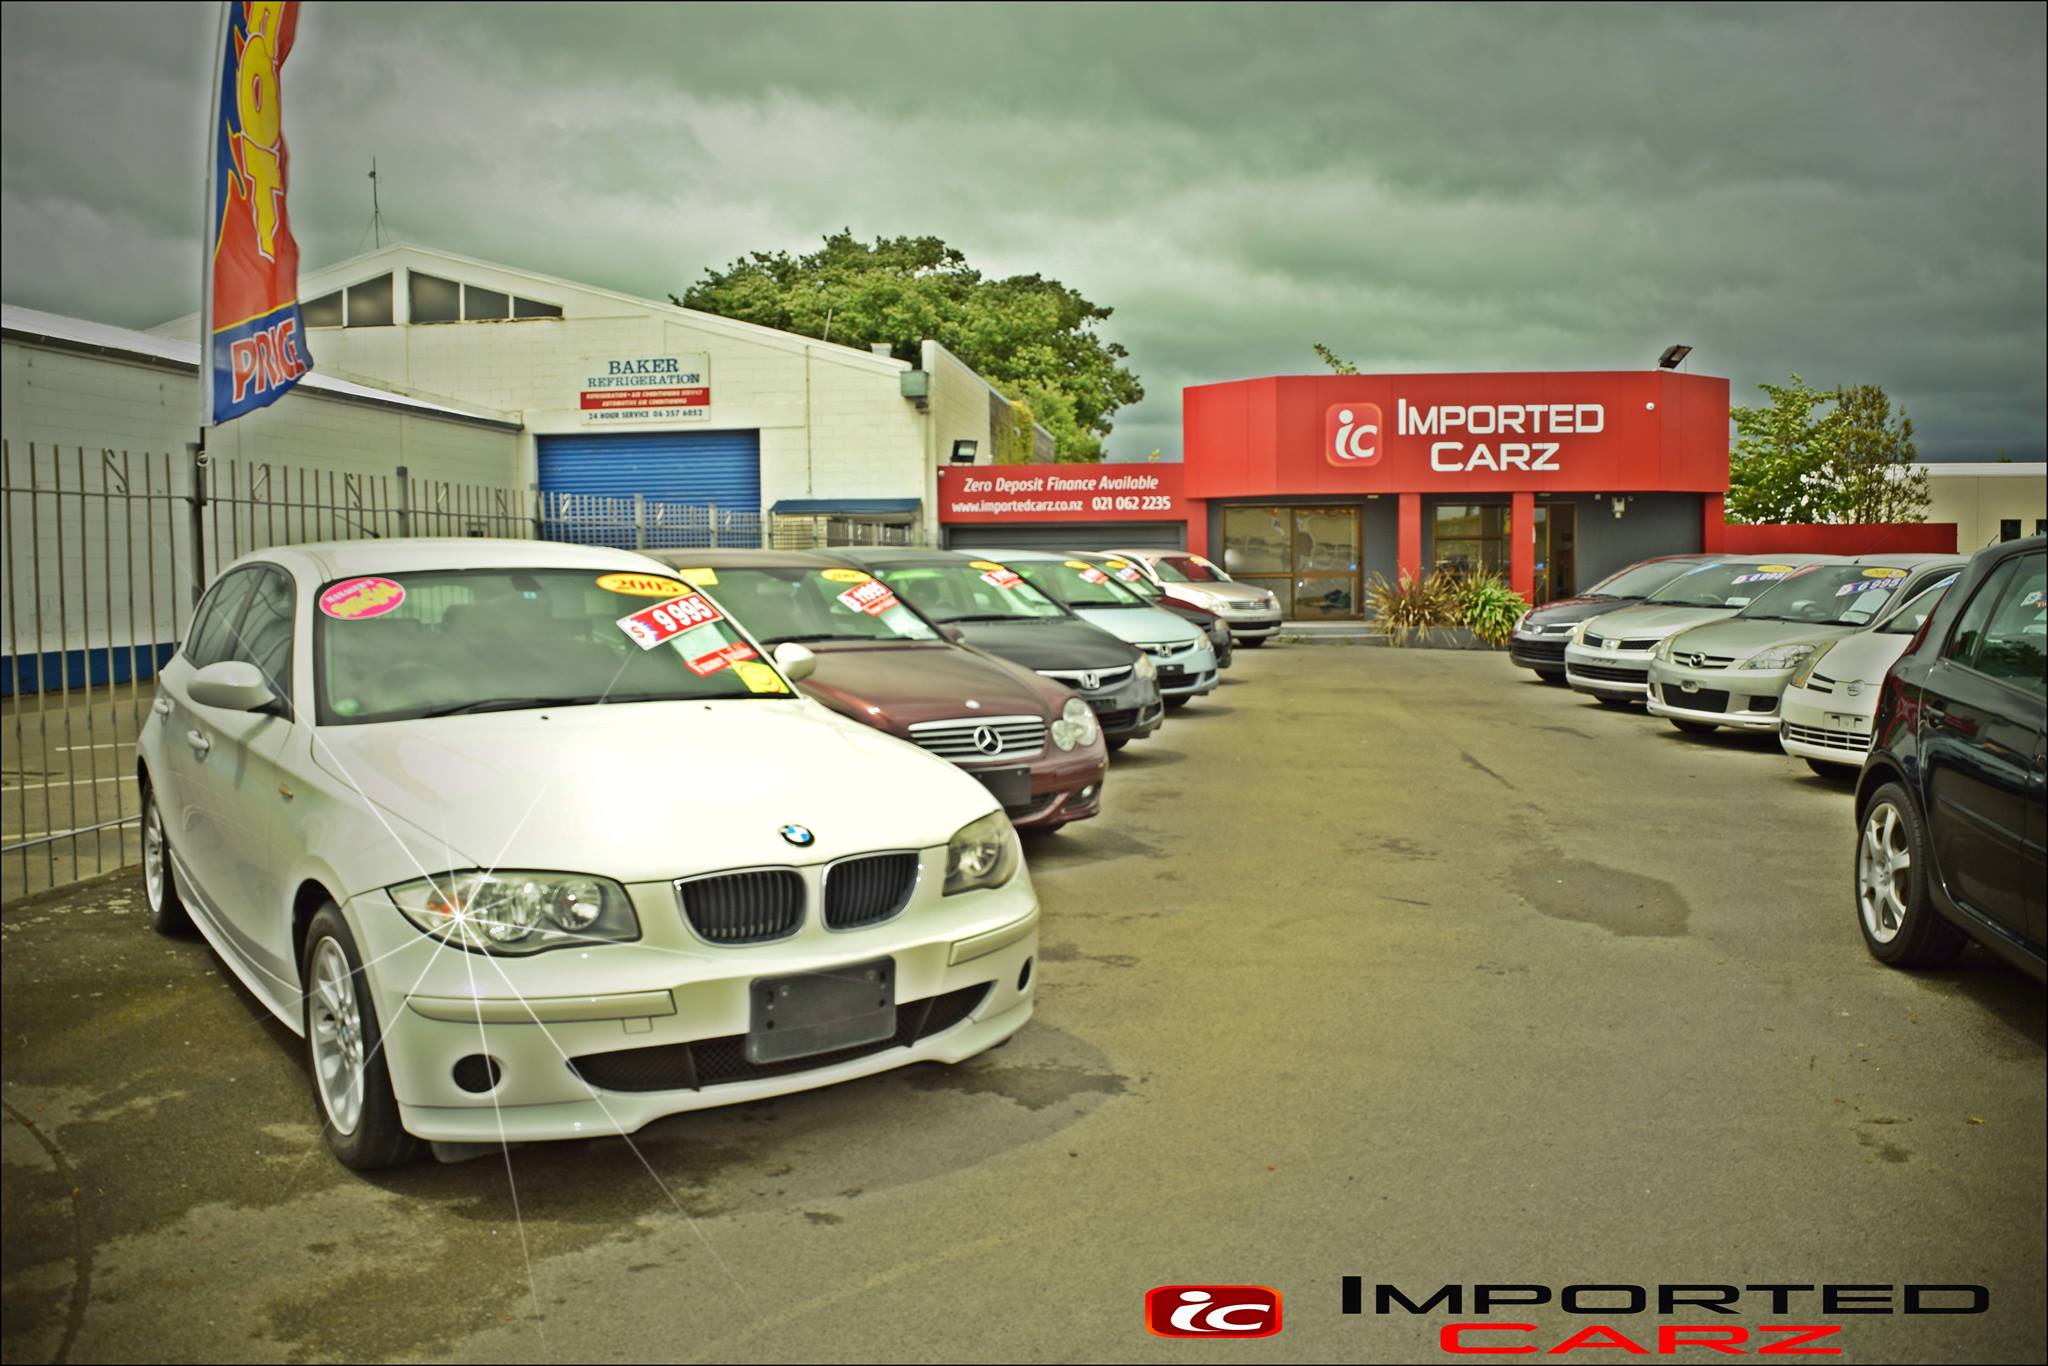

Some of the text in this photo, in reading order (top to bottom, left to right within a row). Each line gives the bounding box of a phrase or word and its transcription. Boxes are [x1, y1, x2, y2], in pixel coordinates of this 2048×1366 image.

[231, 317, 305, 403] PRICE
[608, 358, 679, 375] BAKER
[588, 374, 700, 388] REFRIGERATION
[588, 412, 598, 420] 24
[622, 411, 649, 419] SERVICE
[1398, 398, 1604, 435] IMPORTED
[1430, 441, 1560, 472] CARZ
[963, 475, 1160, 495] Zero Deposit Finance Available
[952, 495, 1172, 514] www.importedcarz.co.nz 021 062 2235
[617, 578, 679, 593] 2005
